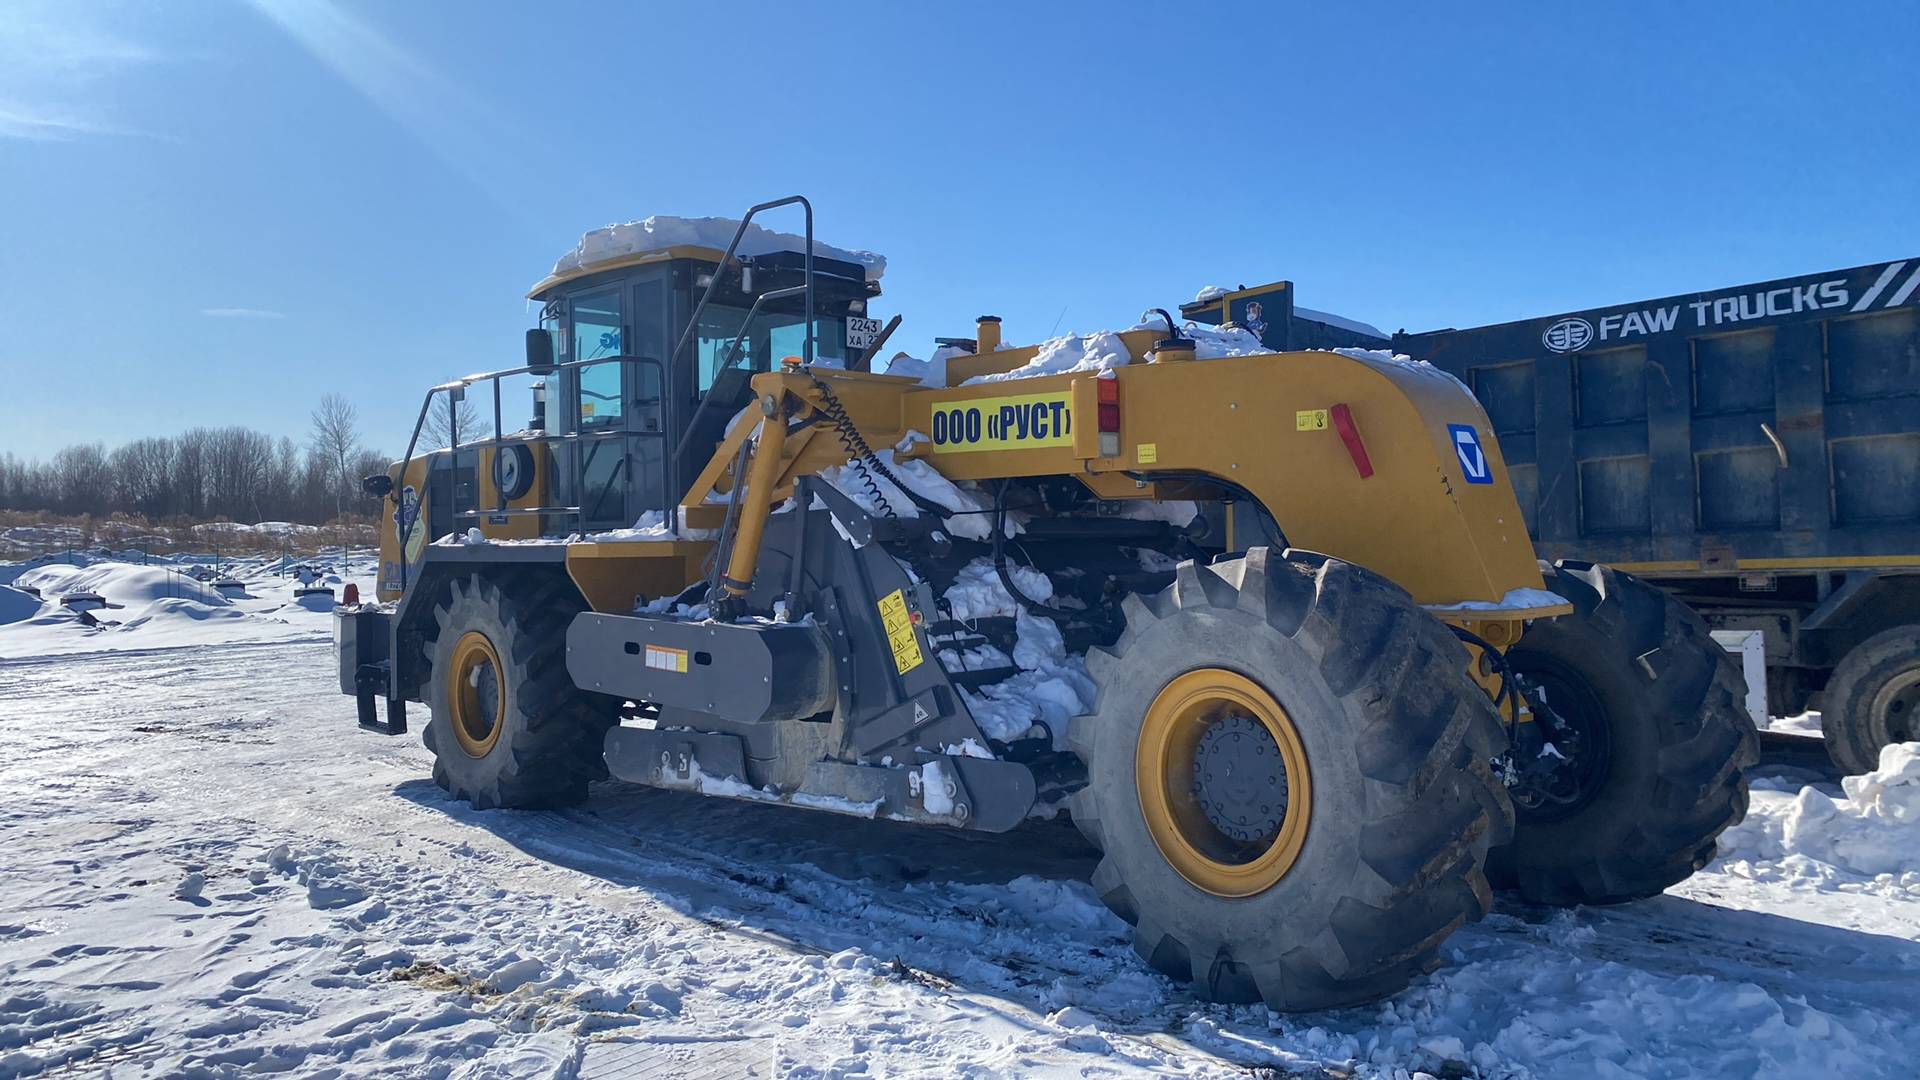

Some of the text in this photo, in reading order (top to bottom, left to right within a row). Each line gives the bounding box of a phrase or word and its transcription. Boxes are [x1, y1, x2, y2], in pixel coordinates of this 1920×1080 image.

[850, 318, 877, 333] 2243
[1600, 278, 1850, 341] FAW TRUCKS
[933, 407, 980, 445] ООО
